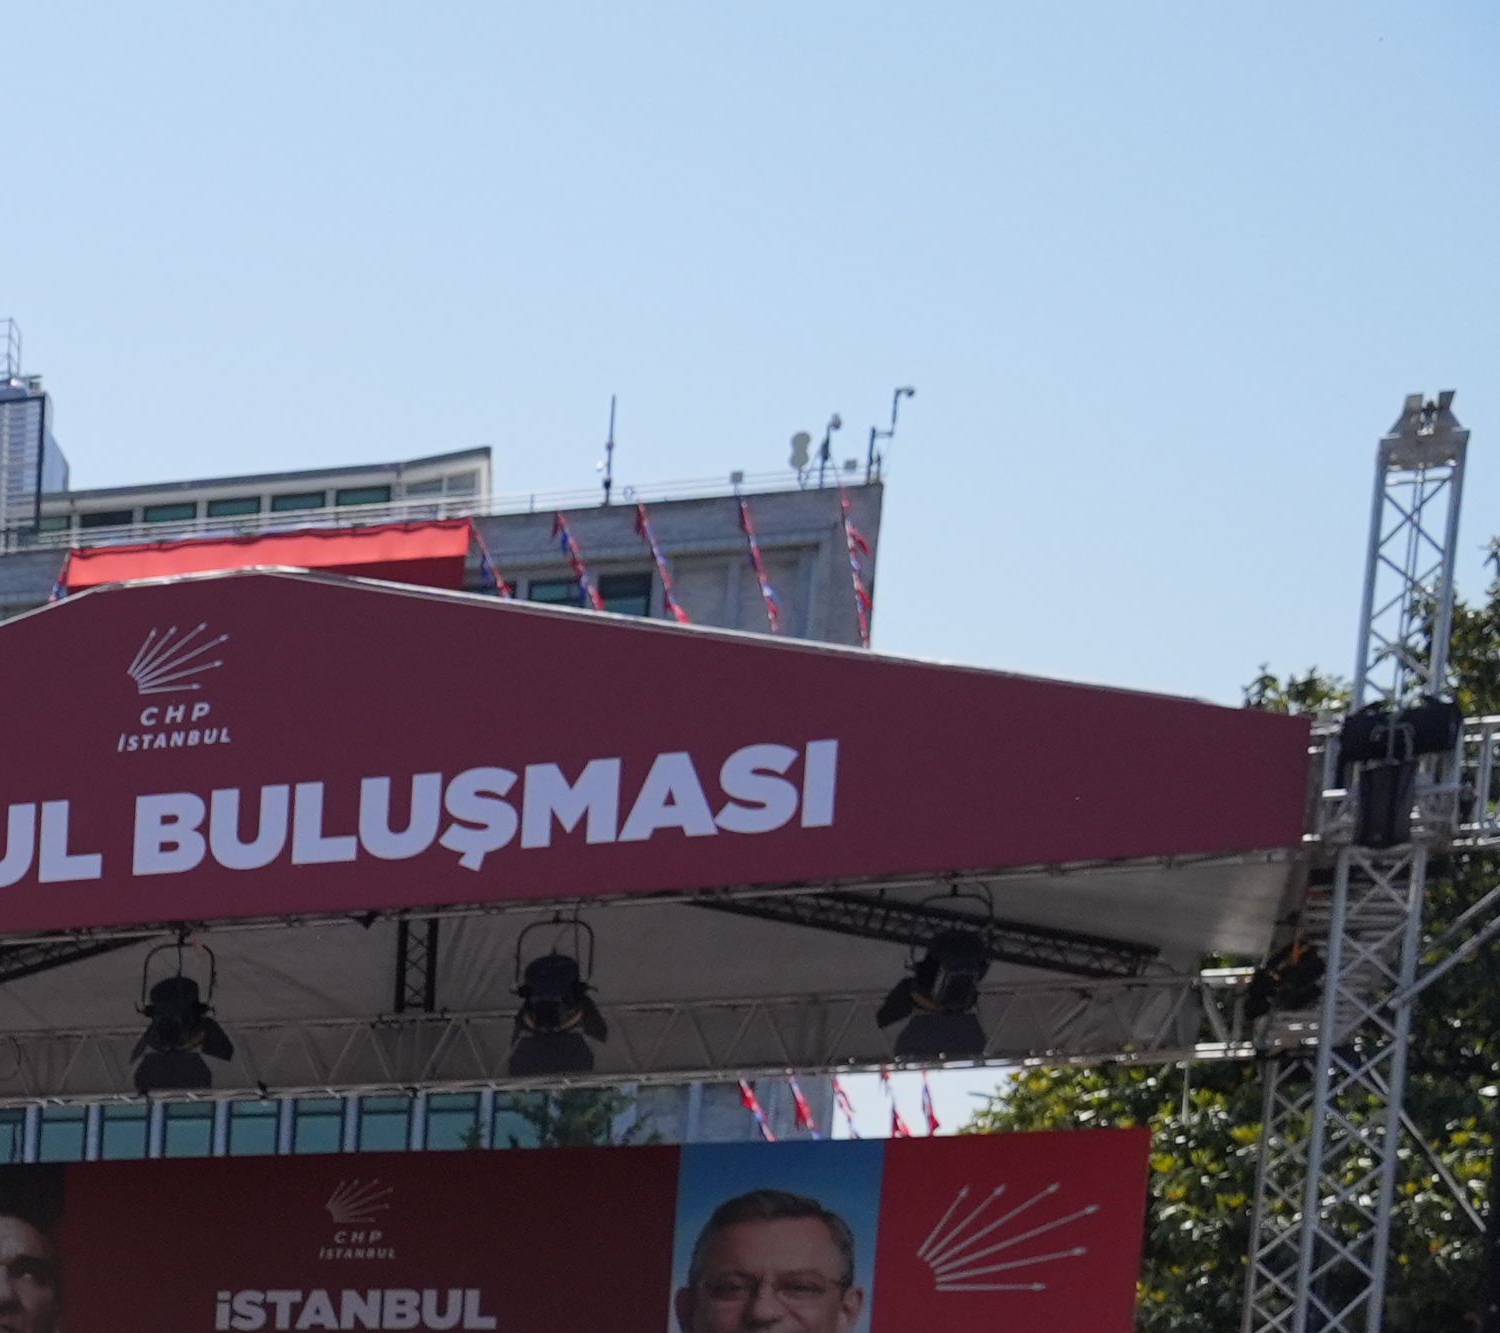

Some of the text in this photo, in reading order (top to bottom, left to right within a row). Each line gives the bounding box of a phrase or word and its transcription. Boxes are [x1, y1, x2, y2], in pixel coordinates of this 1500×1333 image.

[140, 701, 211, 726] CHP
[117, 727, 231, 752] İSTANBUL
[132, 739, 839, 872] BULUŞMASI
[334, 1231, 384, 1244] CHP
[215, 1288, 498, 1331] İSTANBUL
